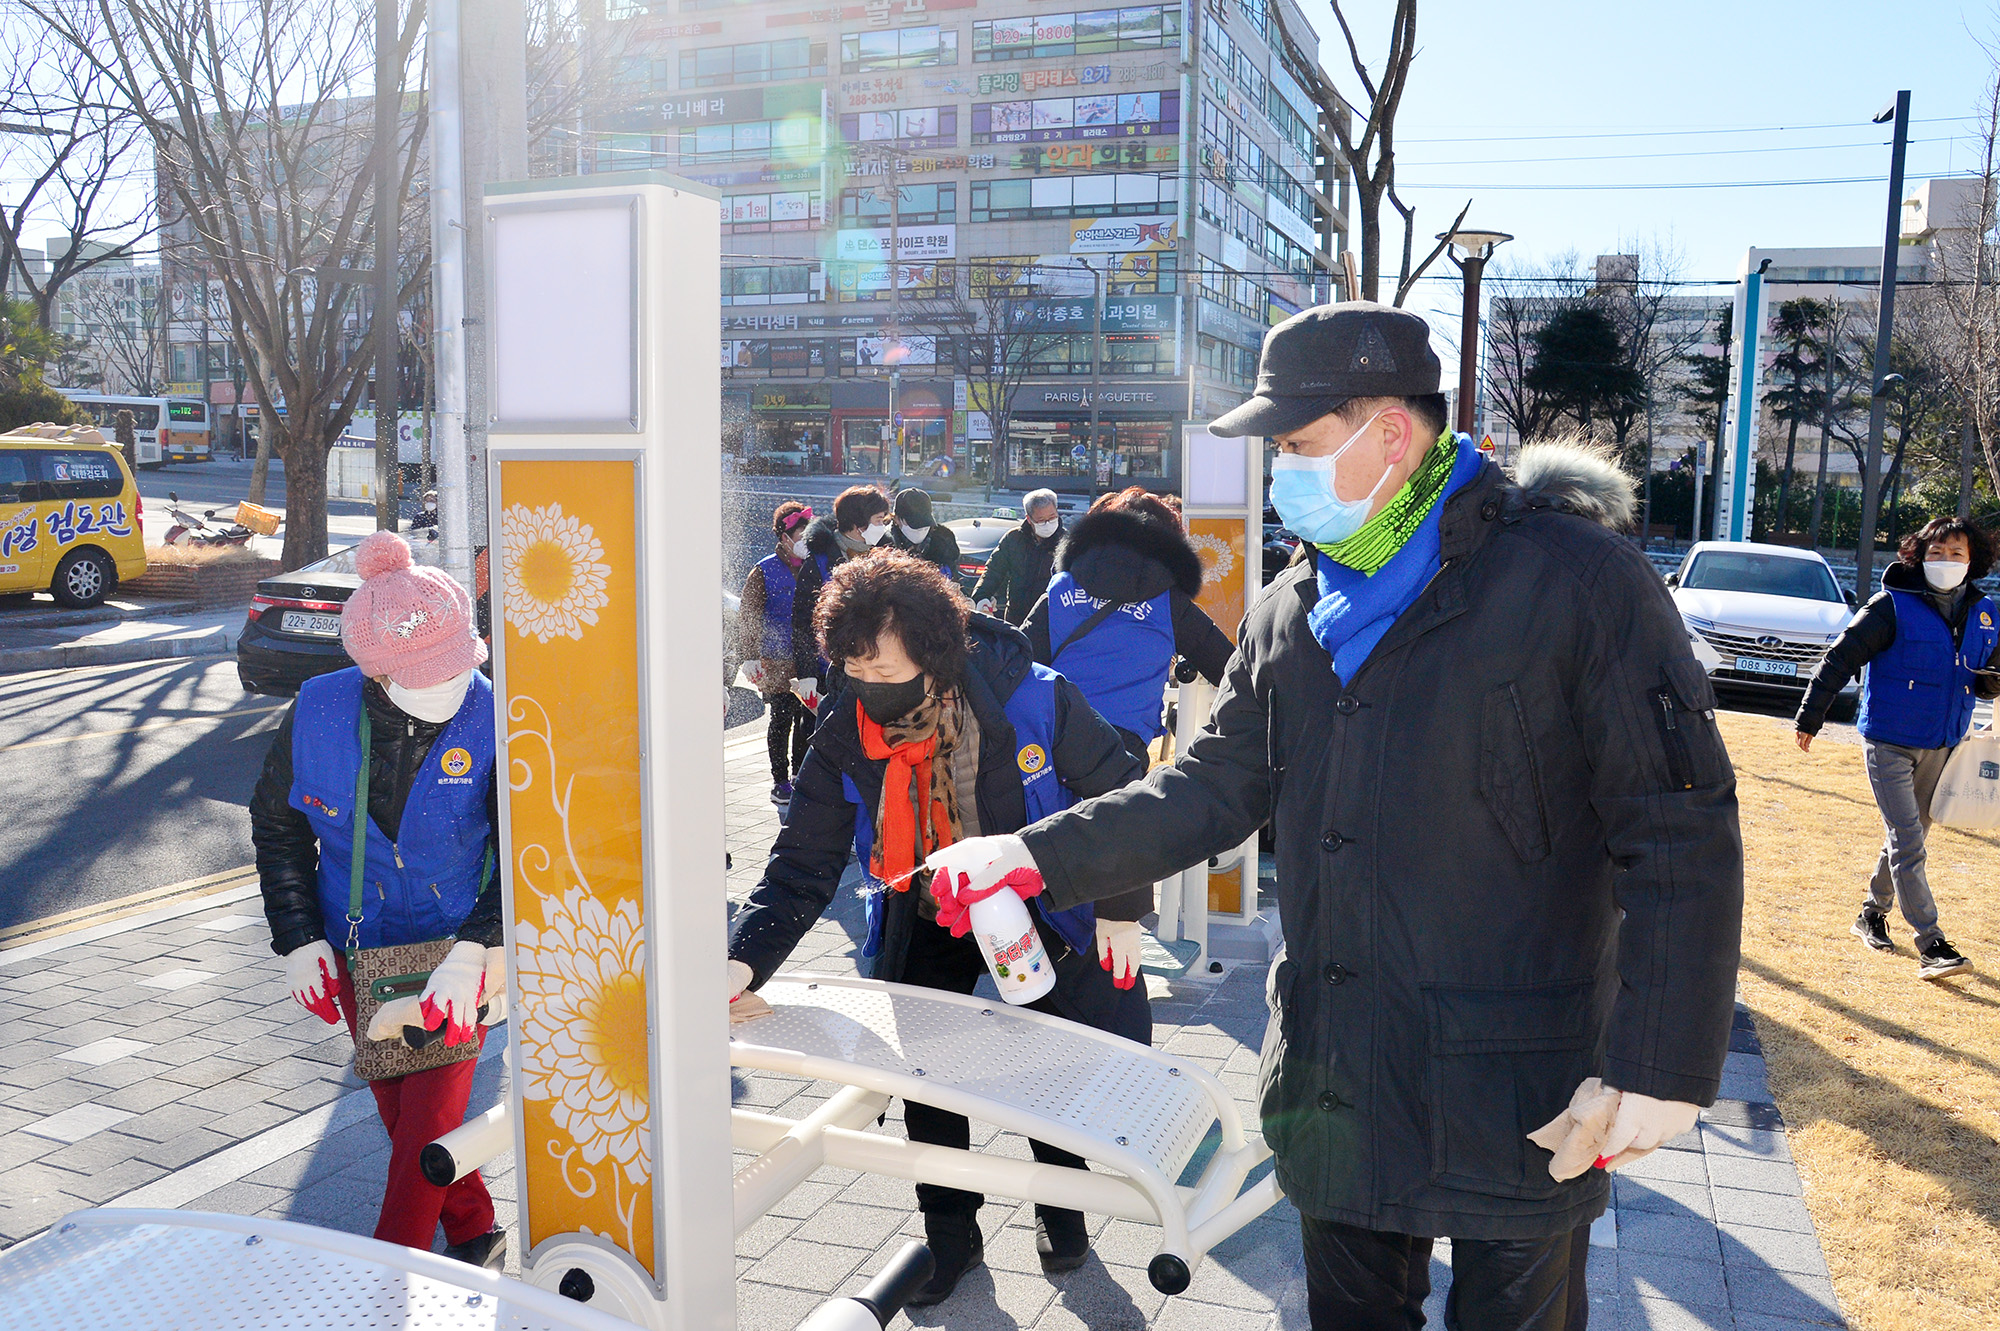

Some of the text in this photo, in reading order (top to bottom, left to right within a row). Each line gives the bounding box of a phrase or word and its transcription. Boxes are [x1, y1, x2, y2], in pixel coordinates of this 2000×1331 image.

[873, 77, 904, 90] 독서실
[978, 73, 1020, 94] 플라잉
[1022, 69, 1078, 91] 필라테스
[1081, 65, 1111, 84] 요가
[848, 92, 897, 106] 288-3306
[660, 98, 726, 120] 유니베라
[1083, 128, 1108, 137] 필라테스
[1153, 147, 1172, 162] 4F
[926, 235, 948, 248] 학원
[733, 314, 798, 330] 스터디센터
[811, 349, 820, 357] 2F
[1044, 392, 1154, 402] PARIS BAGUETTE
[71, 469, 109, 480] 대한검도회
[45, 501, 132, 546] 검도관
[310, 616, 335, 631] 2586
[1764, 662, 1791, 674] 3996
